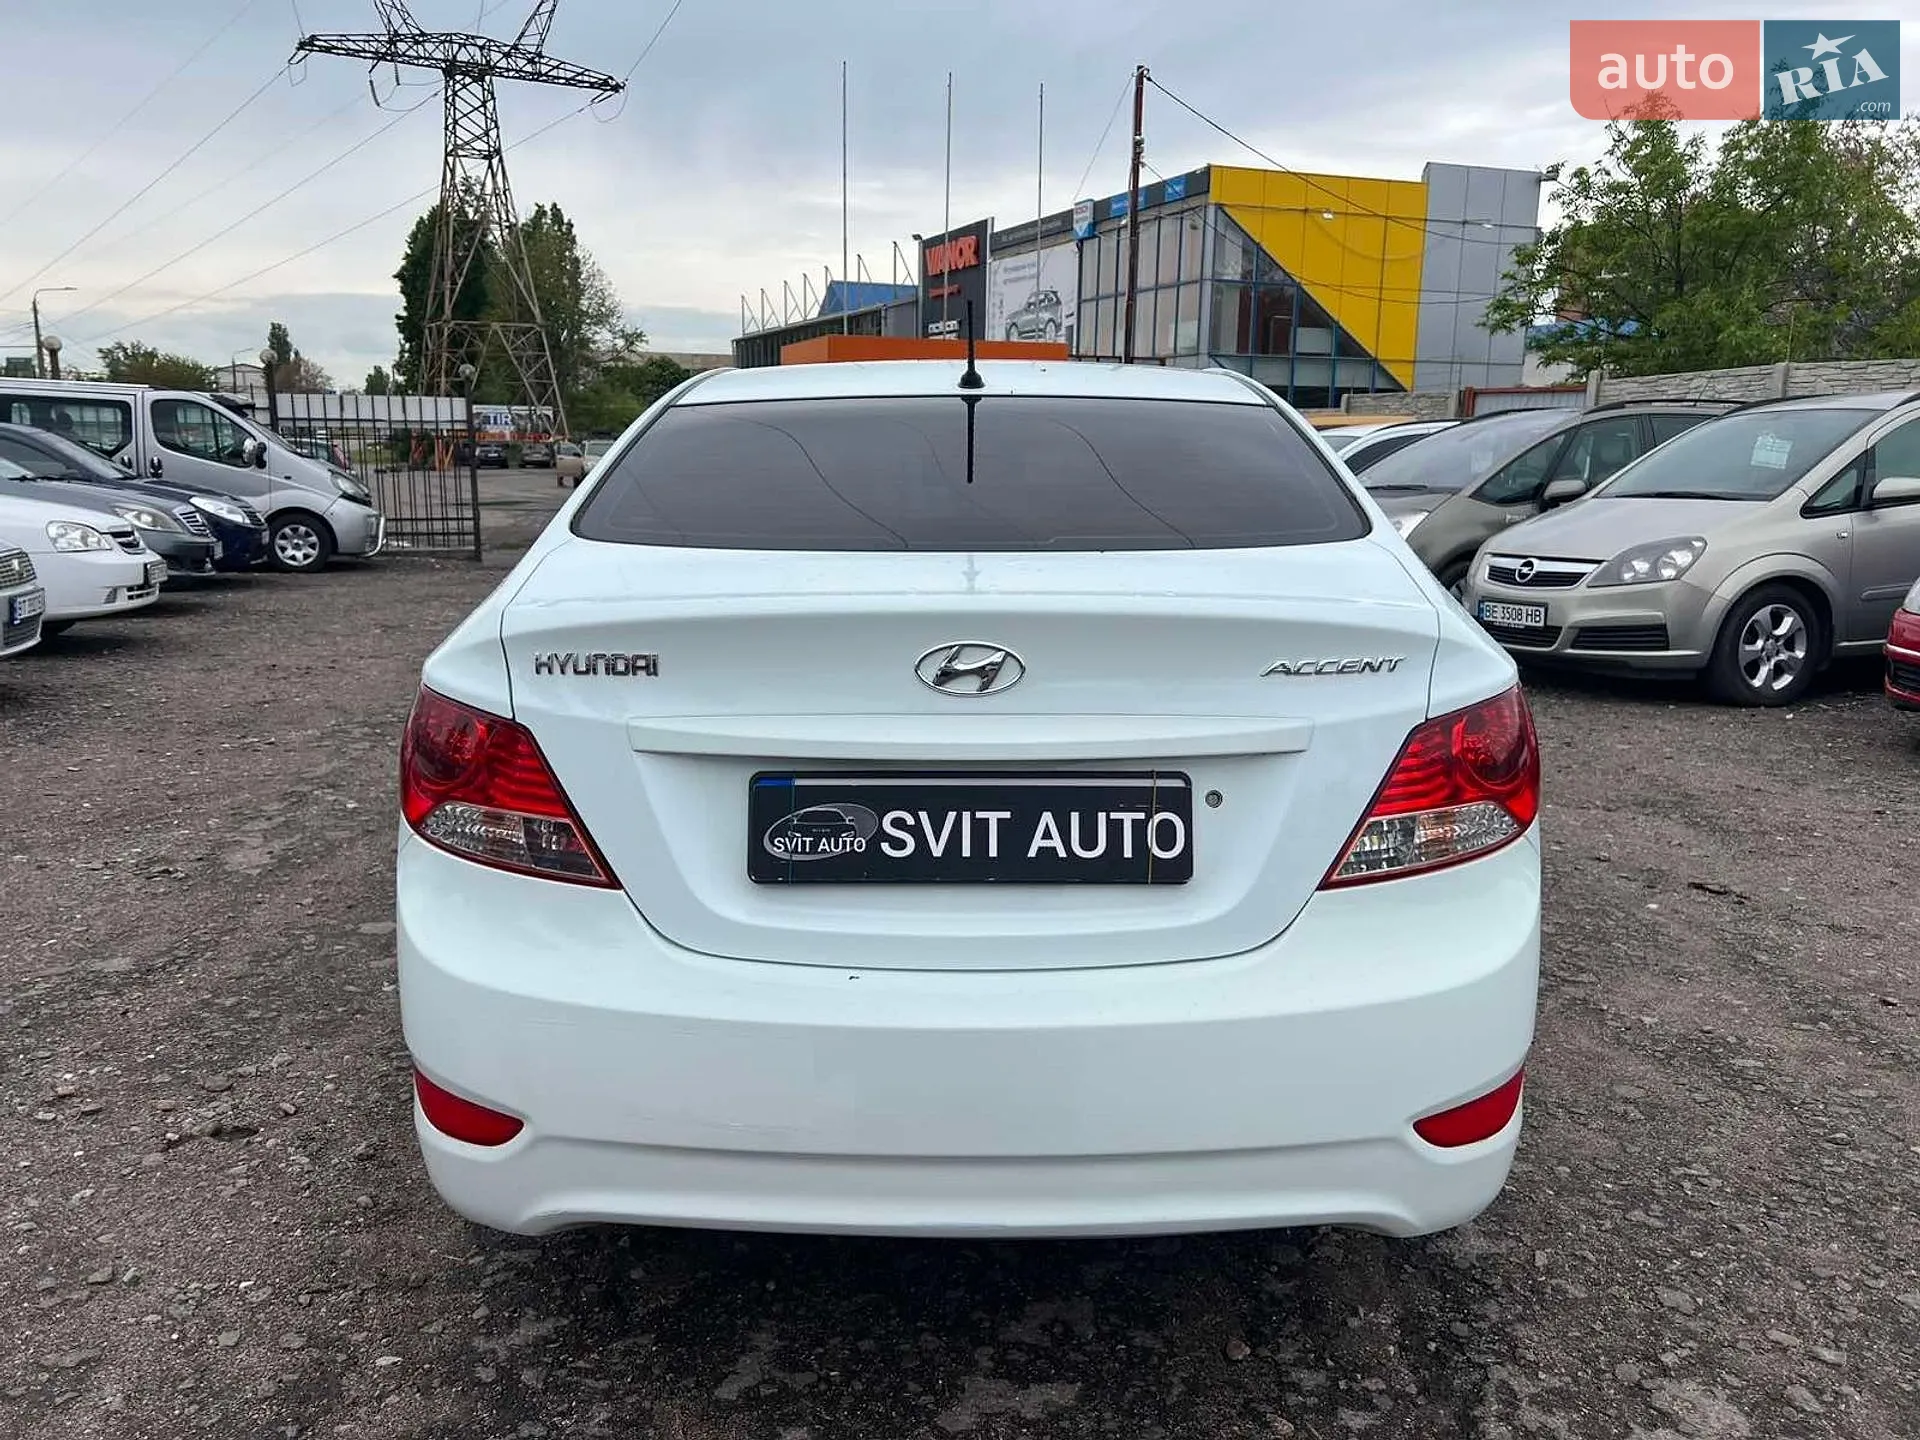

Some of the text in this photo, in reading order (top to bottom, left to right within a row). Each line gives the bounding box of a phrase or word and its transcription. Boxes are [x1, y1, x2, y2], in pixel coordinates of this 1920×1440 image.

[1485, 604, 1498, 619] BE
[1501, 606, 1523, 622] 3508
[534, 652, 659, 676] HYUNDAI
[1259, 656, 1405, 677] ACCENT
[773, 837, 866, 852] SVIT AUTO
[880, 810, 1185, 860] SVIT AUTO
